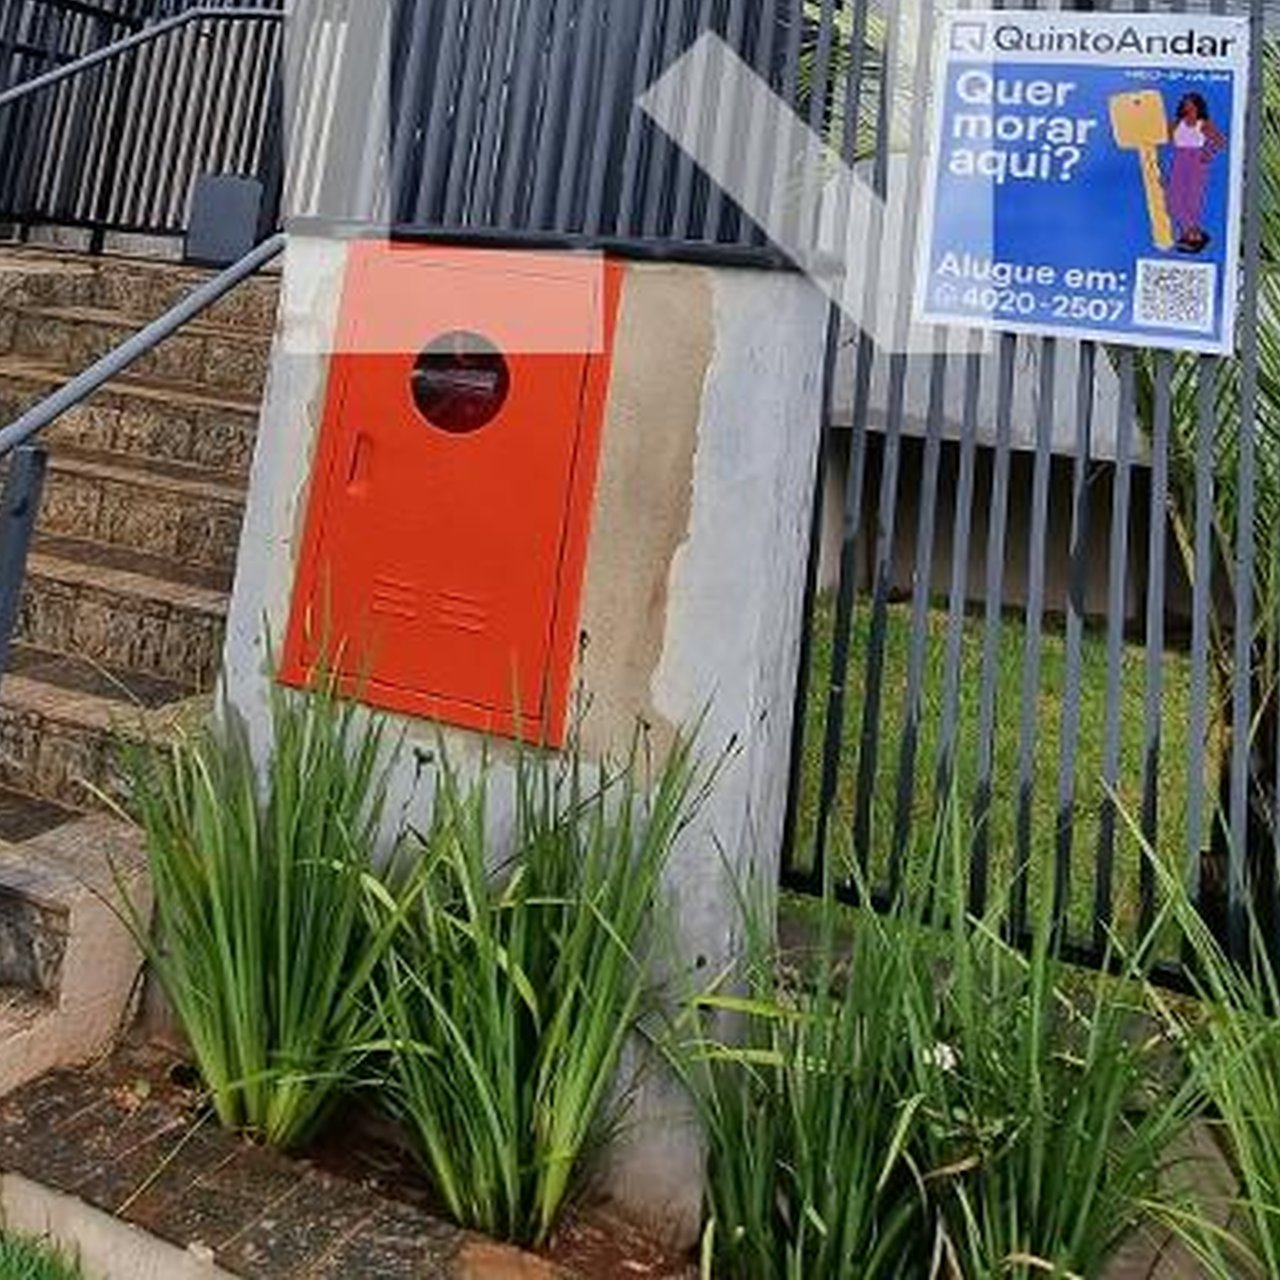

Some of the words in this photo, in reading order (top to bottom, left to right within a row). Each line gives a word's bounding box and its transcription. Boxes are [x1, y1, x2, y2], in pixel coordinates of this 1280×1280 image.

[993, 24, 1236, 58] QuintoAndar
[955, 70, 1075, 107] Quer
[951, 113, 1097, 145] morar
[948, 144, 1081, 184] aqui?
[937, 251, 1056, 288] Alugue
[1064, 267, 1128, 293] em:
